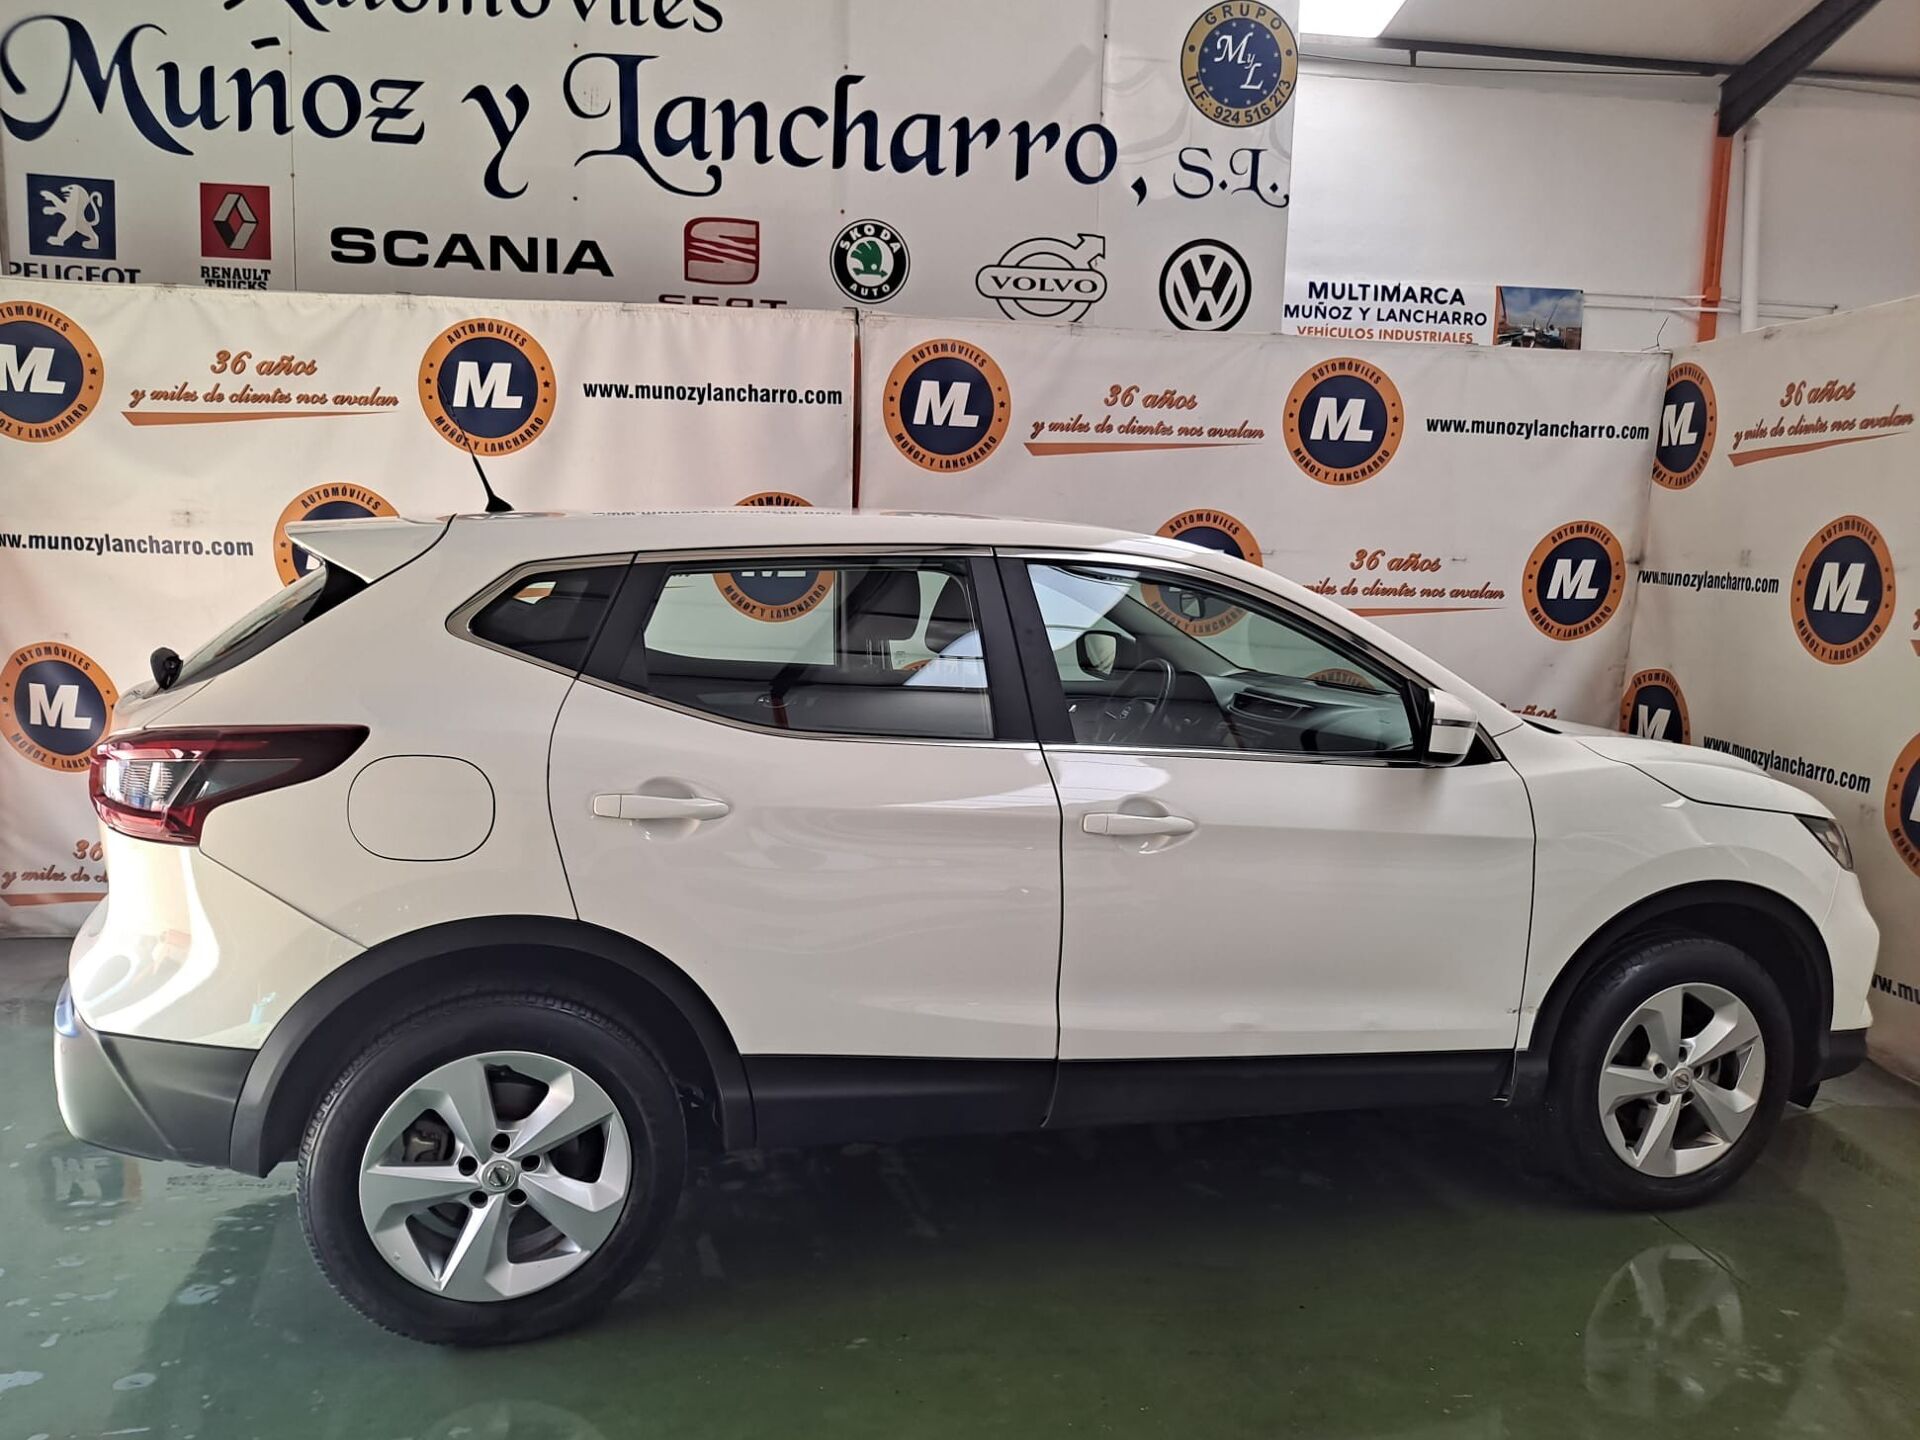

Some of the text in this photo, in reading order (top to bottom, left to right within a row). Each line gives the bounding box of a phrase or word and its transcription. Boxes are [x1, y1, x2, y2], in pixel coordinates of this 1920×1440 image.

[1204, 4, 1282, 31] GRUPO
[0, 14, 1290, 208] Muñoz y Lancharro, S.L.
[1213, 105, 1240, 125] 924
[1245, 104, 1271, 124] 516
[1269, 80, 1291, 107] 273
[330, 226, 614, 277] SCANIA
[839, 224, 901, 253] SKODA
[200, 265, 271, 281] RENAULT
[991, 275, 1098, 294] VOLVO
[850, 283, 890, 297] AUTO
[1308, 281, 1466, 306] MULTIMARCA
[1284, 302, 1487, 326] MUÑOZ Y LANCHARRO
[447, 322, 527, 347] AUTOMÓVILES
[1297, 323, 1474, 345] VEHÍCULOS INDUSTRIALES
[210, 350, 318, 376] 36 años
[912, 342, 988, 368] AUTOMÓVILES
[453, 361, 523, 409] ML
[1311, 361, 1382, 385] AUTOMÓVILES
[129, 382, 399, 408] y miles de clientes nos avalan
[583, 382, 843, 405] www.munozylancharro.com
[912, 380, 980, 428] ML
[1103, 384, 1199, 410] 36 años
[1780, 379, 1856, 407] 36 años
[29, 403, 88, 439] LANCHARRO
[1030, 414, 1265, 440] y miles de clientes nos avalan
[1309, 396, 1374, 442] ML
[1426, 416, 1650, 440] www.munozylancharro.com
[1661, 401, 1699, 448] ML
[1732, 404, 1915, 450] y miles de clientes nos avalan
[474, 440, 480, 450] Y
[484, 417, 544, 453] LANCHARRO
[895, 432, 998, 469] MUÑOZ Y LANCHARRO
[1293, 447, 1391, 482] MUÑOZ Y LANCHARRO
[301, 485, 382, 511] AUTOMÓVILES
[1168, 512, 1240, 535] AUTOMÓVILES
[1551, 523, 1611, 545] AUTOMÓVILES
[1820, 520, 1878, 545] AUTOMÓVILES
[1350, 549, 1442, 572] 36 años
[1340, 578, 1359, 595] de
[1362, 579, 1416, 598] clientes
[1420, 587, 1446, 598] nos
[1450, 581, 1505, 600] avalan
[1546, 558, 1600, 600] ML
[1812, 562, 1869, 614] ML
[15, 646, 91, 672] AUTOMÓVILES
[28, 682, 92, 730] ML
[1703, 735, 1872, 794] www.munozylancharro.com
[72, 839, 104, 861] 36
[1, 871, 17, 890] y
[21, 864, 67, 881] miles
[70, 866, 90, 882] de
